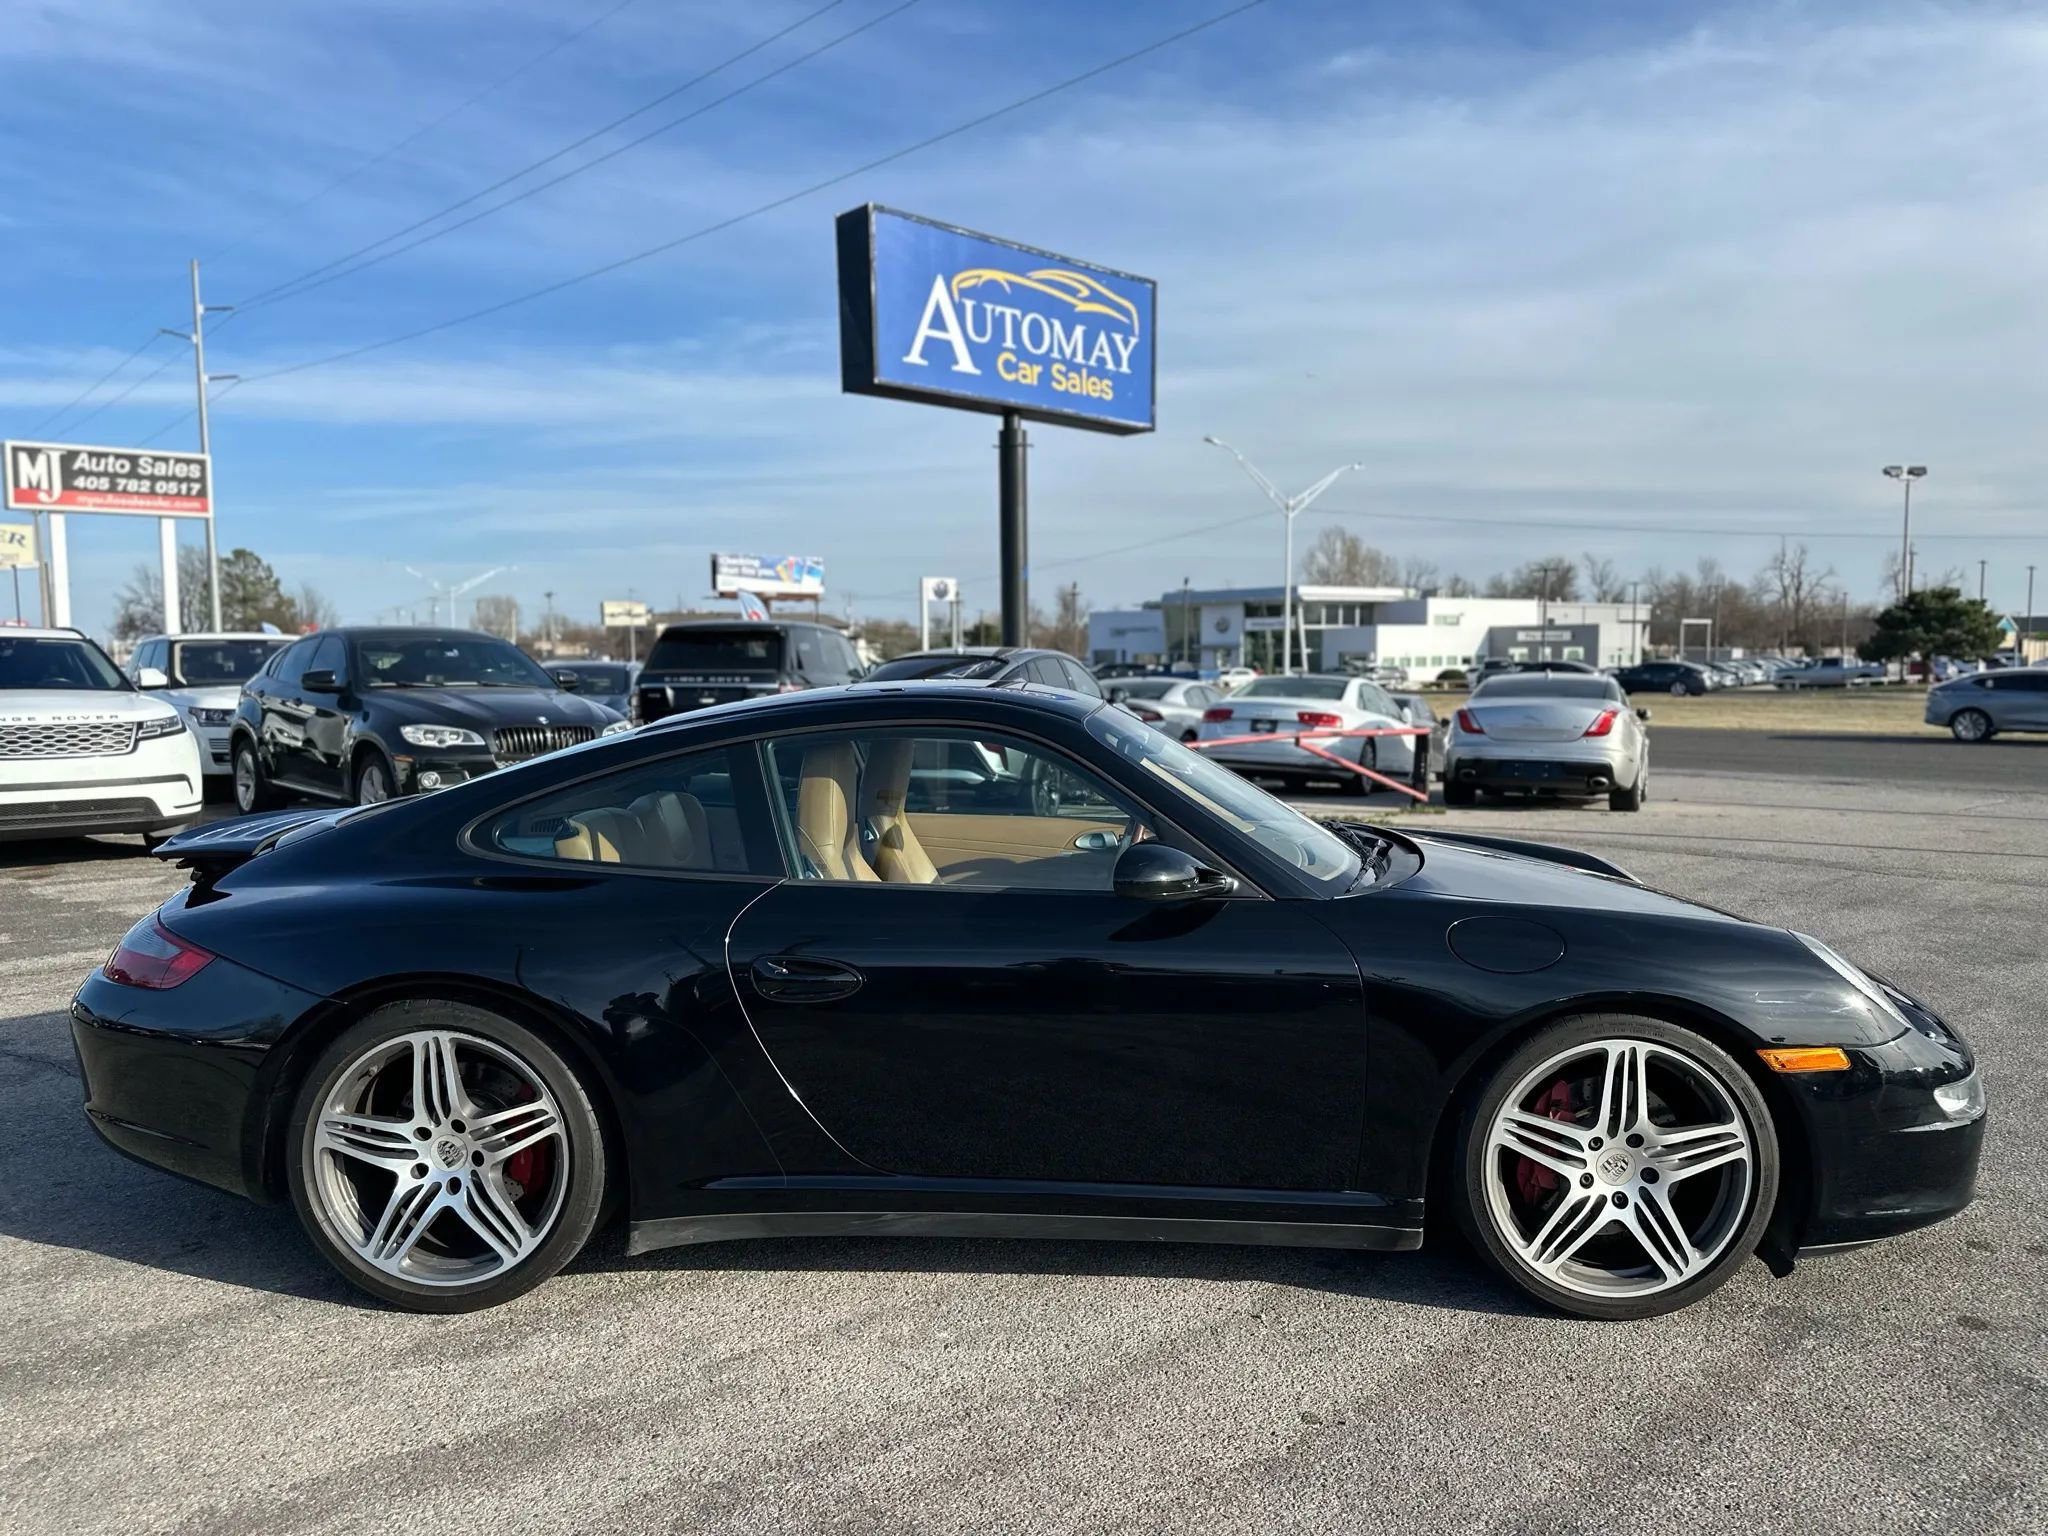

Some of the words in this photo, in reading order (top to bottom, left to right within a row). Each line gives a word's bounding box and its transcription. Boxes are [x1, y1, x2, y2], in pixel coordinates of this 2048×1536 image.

[997, 352, 1043, 386] Car
[1051, 363, 1114, 401] Sales
[17, 449, 67, 503] MJ
[72, 452, 131, 474] Auto
[137, 457, 202, 479] Sales
[73, 476, 109, 490] 405
[115, 479, 150, 493] 782
[155, 481, 202, 495] 0517
